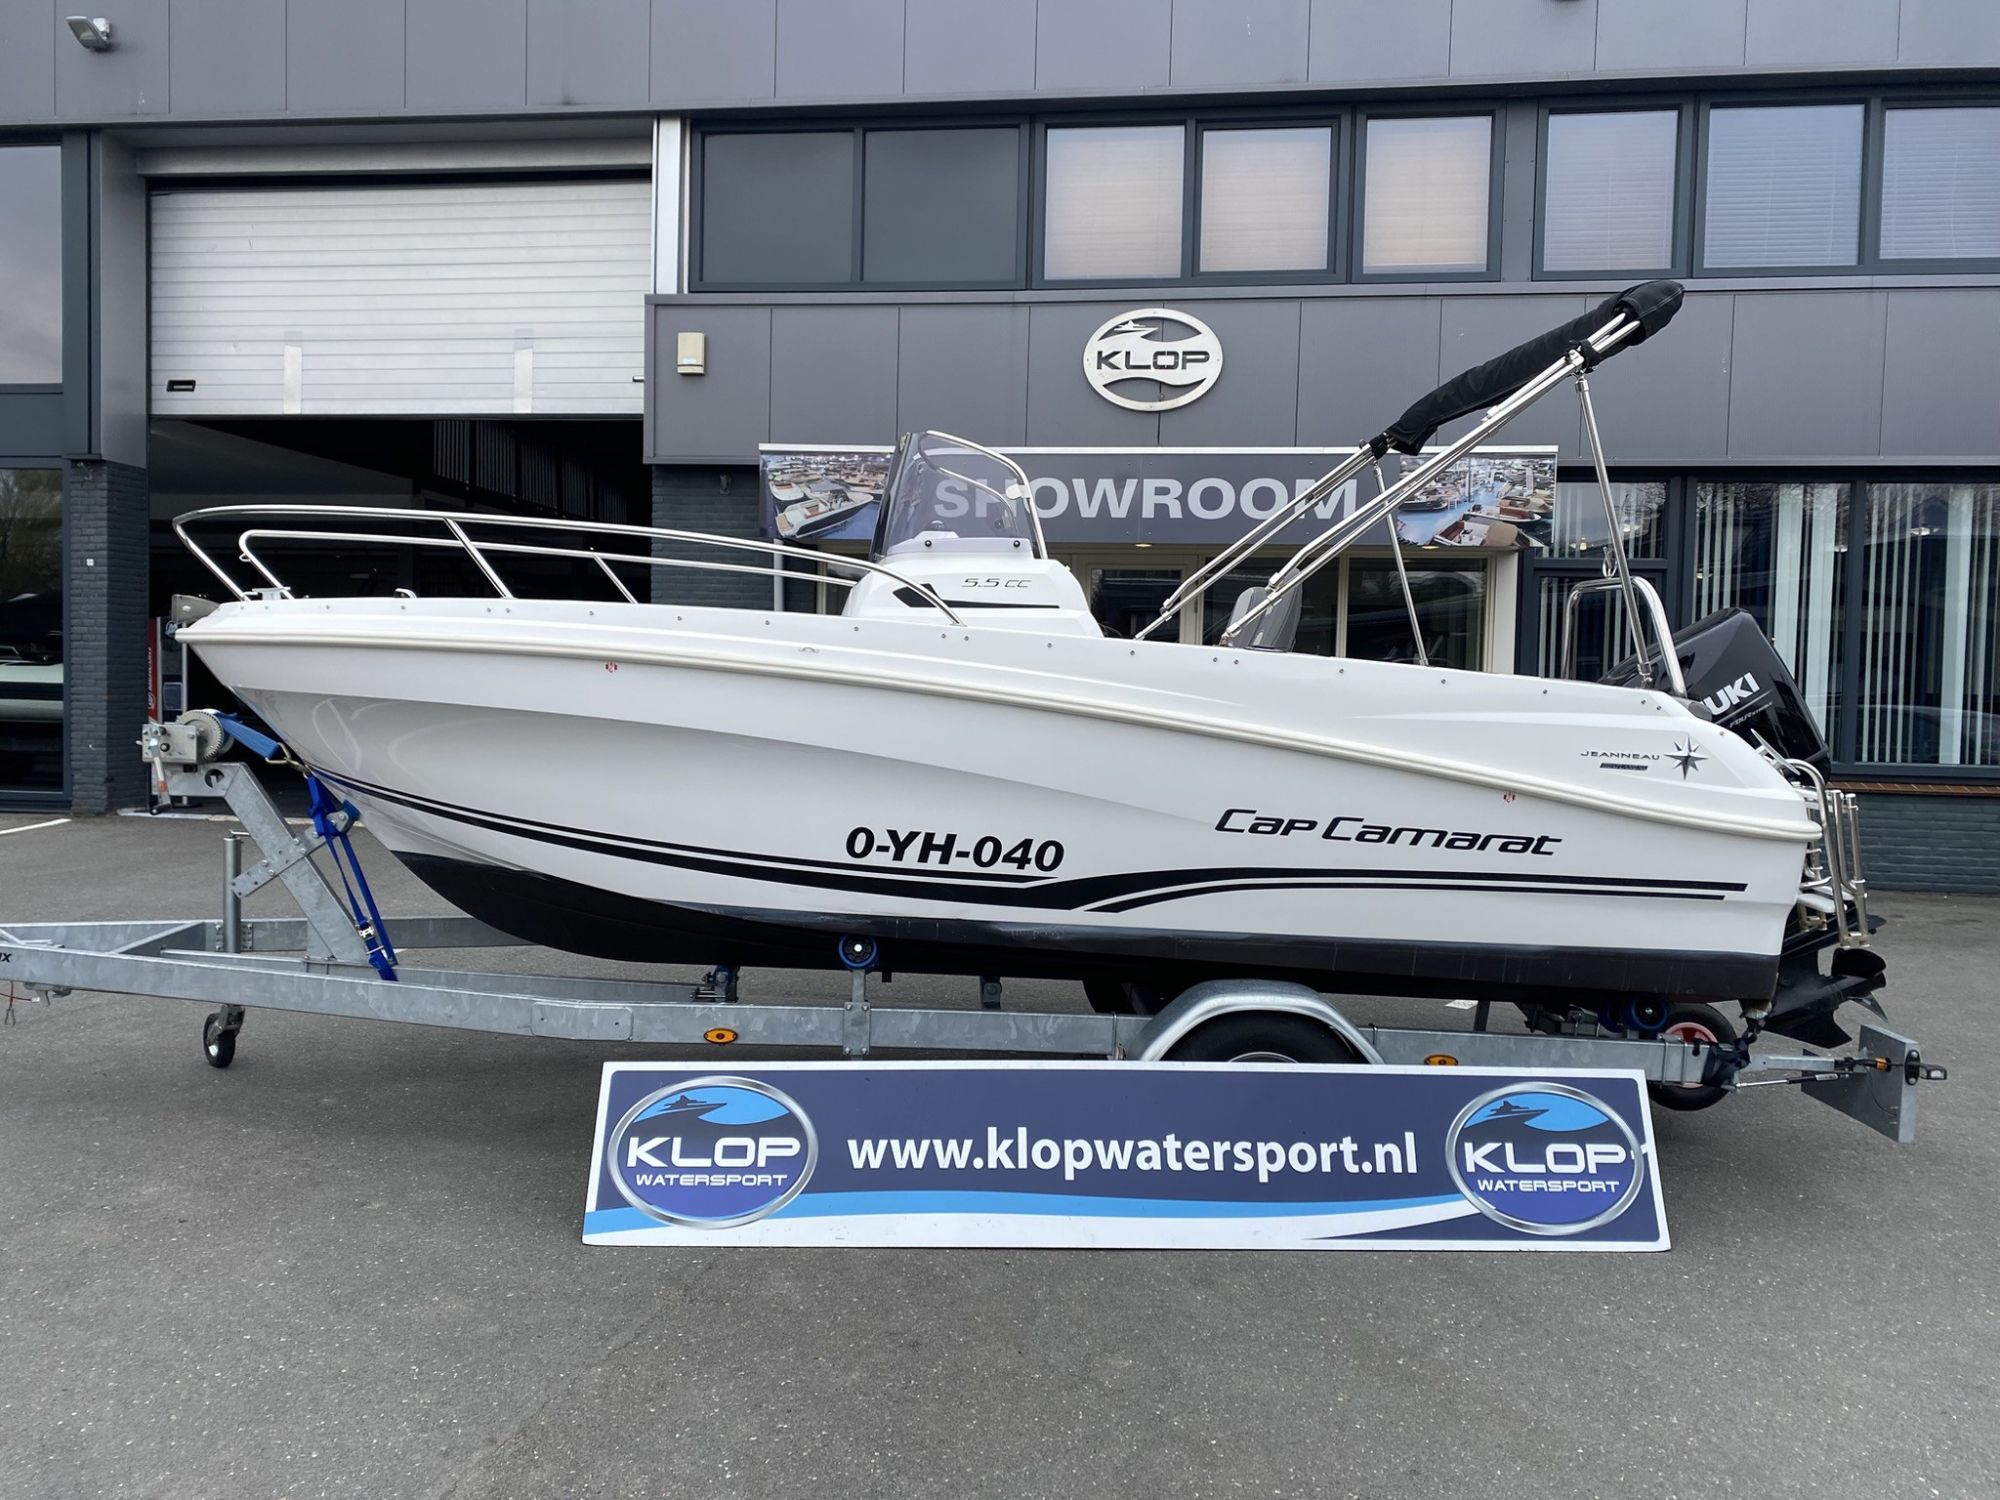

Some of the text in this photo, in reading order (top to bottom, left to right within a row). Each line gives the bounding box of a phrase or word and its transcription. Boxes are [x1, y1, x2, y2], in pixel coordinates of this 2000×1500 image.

[1096, 350, 1210, 370] KLOP
[934, 477, 1357, 520] SHOWROOM
[962, 578, 1000, 588] 5.5
[1700, 672, 1760, 715] UKI
[1580, 750, 1660, 761] JEANNEAU
[1215, 809, 1563, 856] Cap Camarat
[626, 1136, 801, 1168] KLOP
[847, 1126, 1418, 1183] www.klopwatersport.nl
[1464, 1142, 1626, 1173] KLOP
[636, 1174, 788, 1187] WATERSPORT
[1477, 1179, 1620, 1193] WATERSPORT
